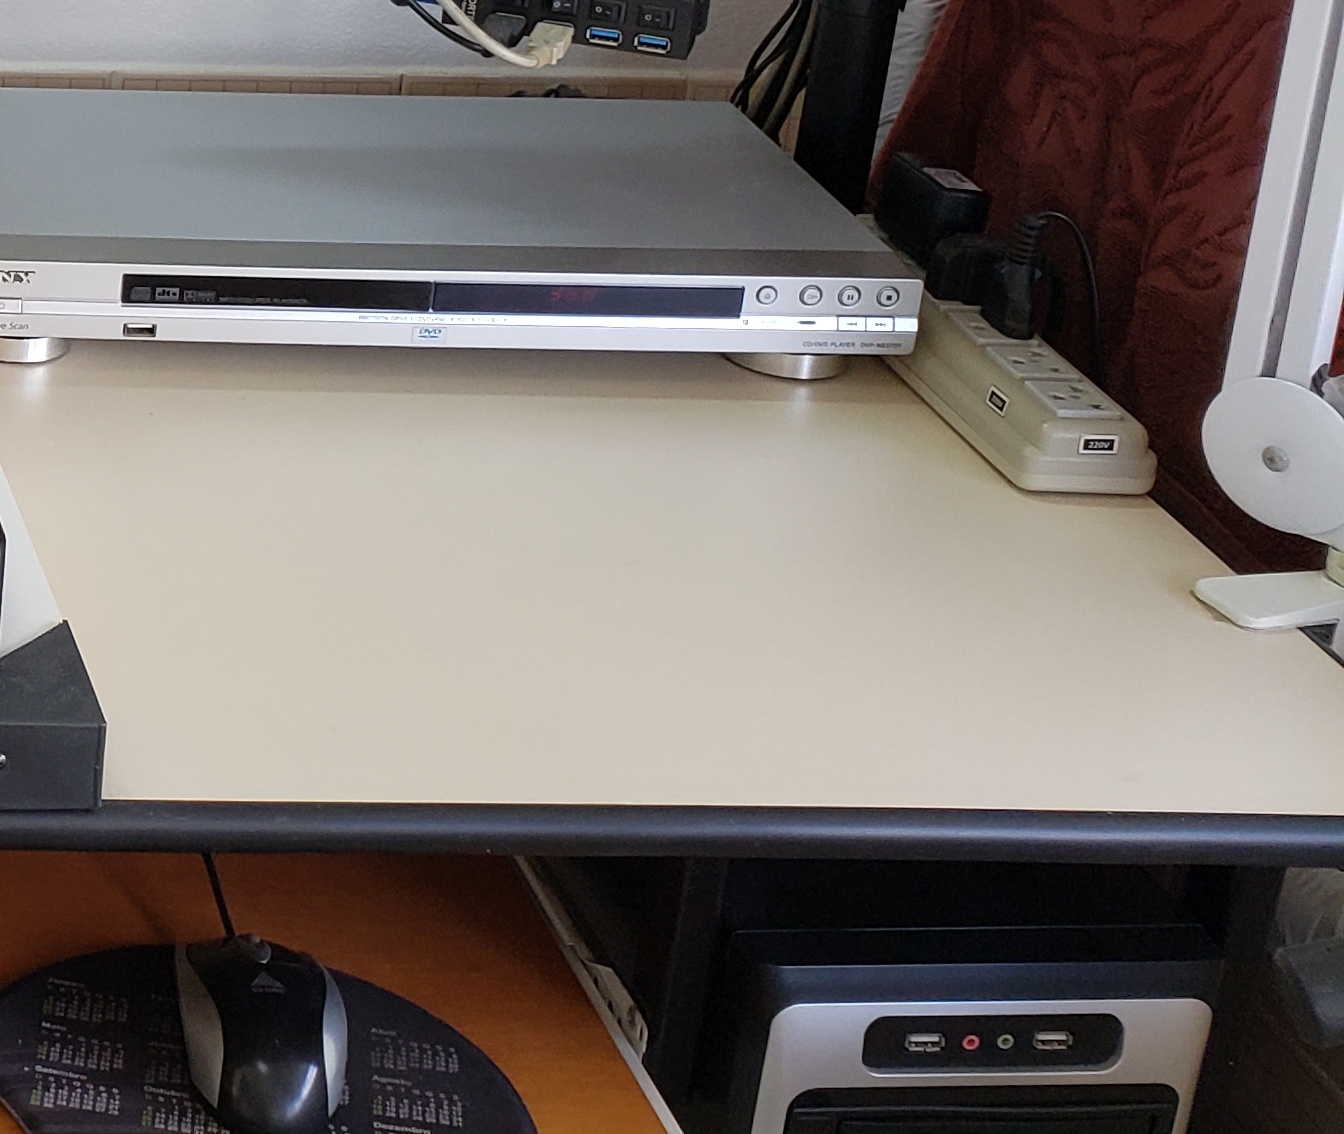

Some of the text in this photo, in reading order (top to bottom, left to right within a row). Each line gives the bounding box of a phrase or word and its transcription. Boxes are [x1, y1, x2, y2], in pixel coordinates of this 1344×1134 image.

[8, 320, 29, 331] Scan
[418, 328, 442, 336] DVD
[1086, 439, 1112, 450] 220V
